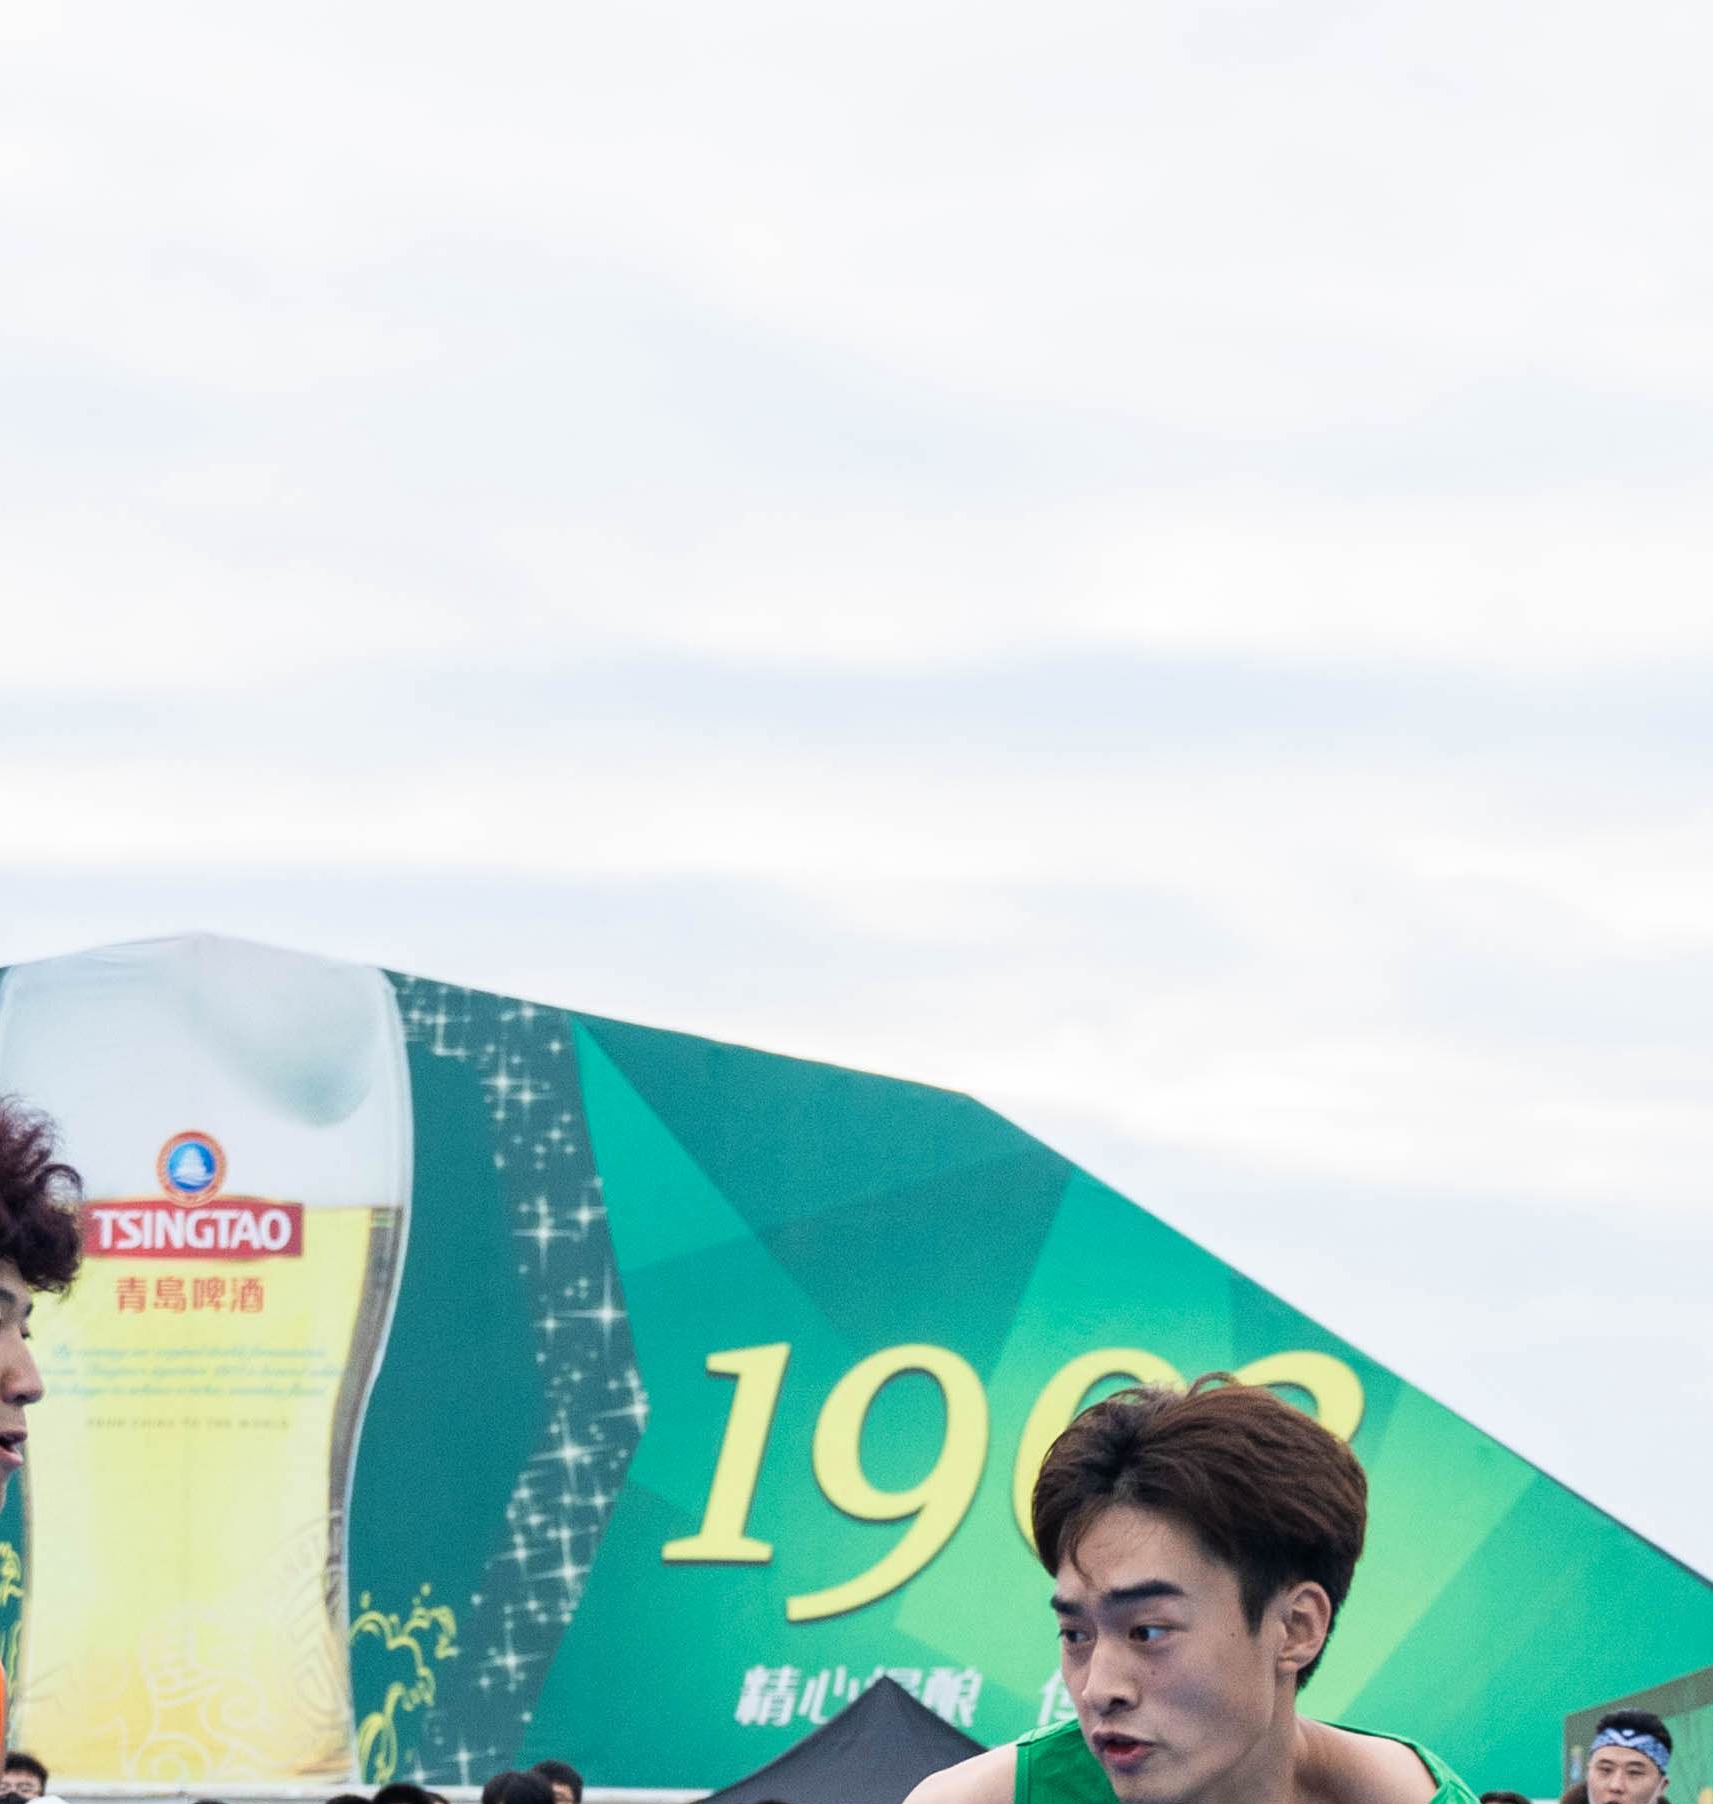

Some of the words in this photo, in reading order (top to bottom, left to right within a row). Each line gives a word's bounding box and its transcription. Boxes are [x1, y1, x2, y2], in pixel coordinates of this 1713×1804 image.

[93, 1209, 292, 1250] TSINGTAO
[115, 1276, 264, 1313] 青島啤酒
